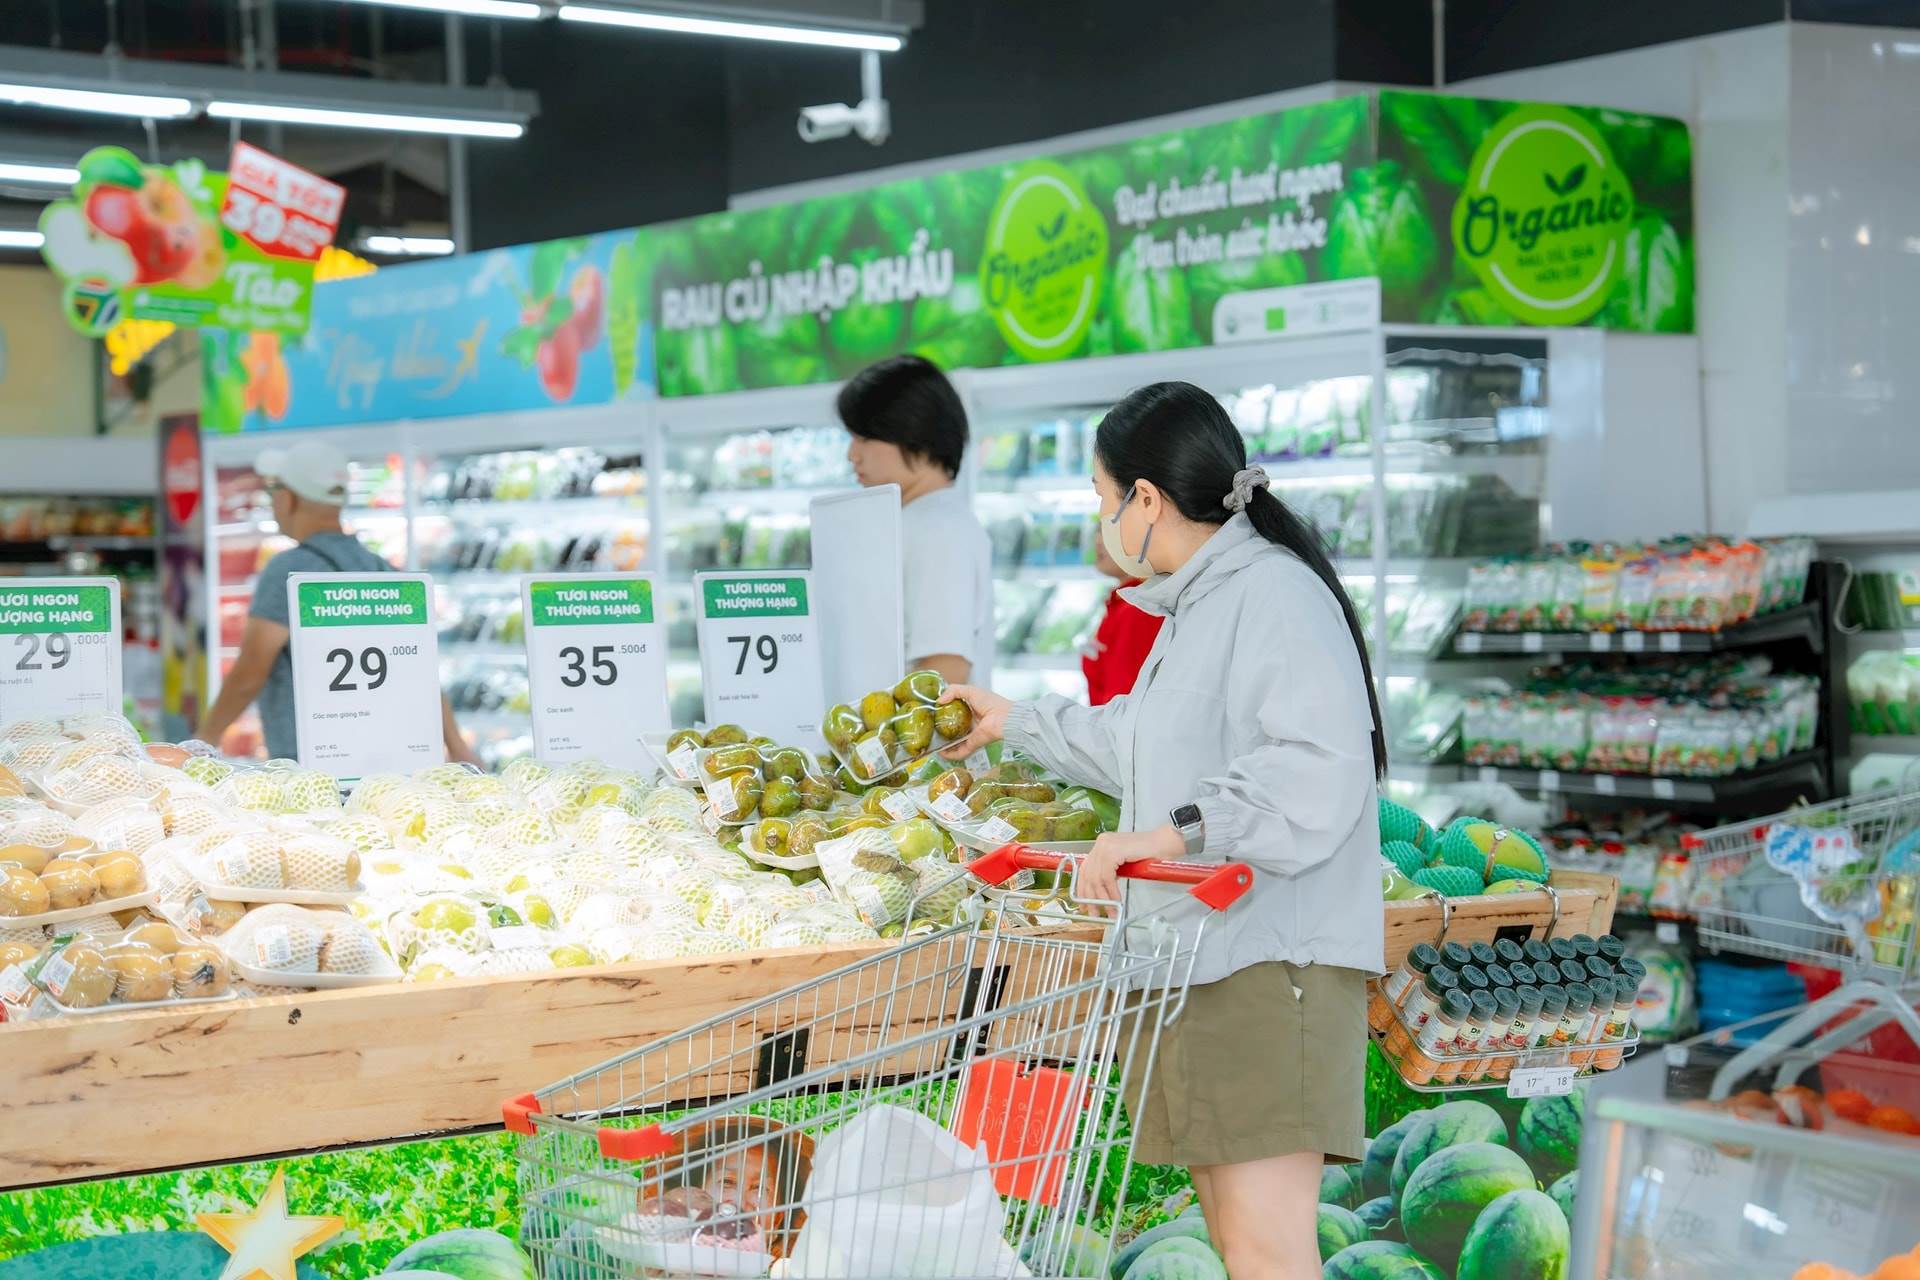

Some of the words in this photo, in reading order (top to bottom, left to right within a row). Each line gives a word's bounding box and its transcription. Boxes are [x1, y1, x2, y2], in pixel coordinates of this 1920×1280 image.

[1463, 180, 1629, 258] Organic
[985, 222, 1099, 310] Organic
[661, 283, 722, 331] RAU
[724, 260, 769, 323] CỦ
[771, 255, 859, 324] NHẬP
[861, 228, 955, 304] KHẨU
[324, 589, 357, 600] TƯƠI
[360, 589, 400, 600] NGON
[556, 590, 587, 601] TƯƠI
[590, 590, 628, 600] NGON
[724, 584, 752, 594] TƯƠI
[754, 583, 786, 593] NGON
[0, 593, 28, 606] ƯƠI
[33, 594, 80, 606] NGON
[715, 598, 764, 611] THƯỢNG
[766, 597, 798, 611] HẠNG
[0, 610, 45, 626] ƯỢNG
[48, 611, 94, 625] HẠNG
[312, 604, 371, 619] THƯỢNG
[375, 604, 413, 618] HẠNG
[545, 604, 601, 619] THƯỢNG
[604, 604, 641, 618] HẠNG
[14, 632, 71, 670] 29
[728, 635, 778, 675] 79
[326, 647, 387, 691] 29
[559, 646, 618, 687] 35
[1527, 1078, 1537, 1088] 17
[1558, 1076, 1568, 1086] 18
